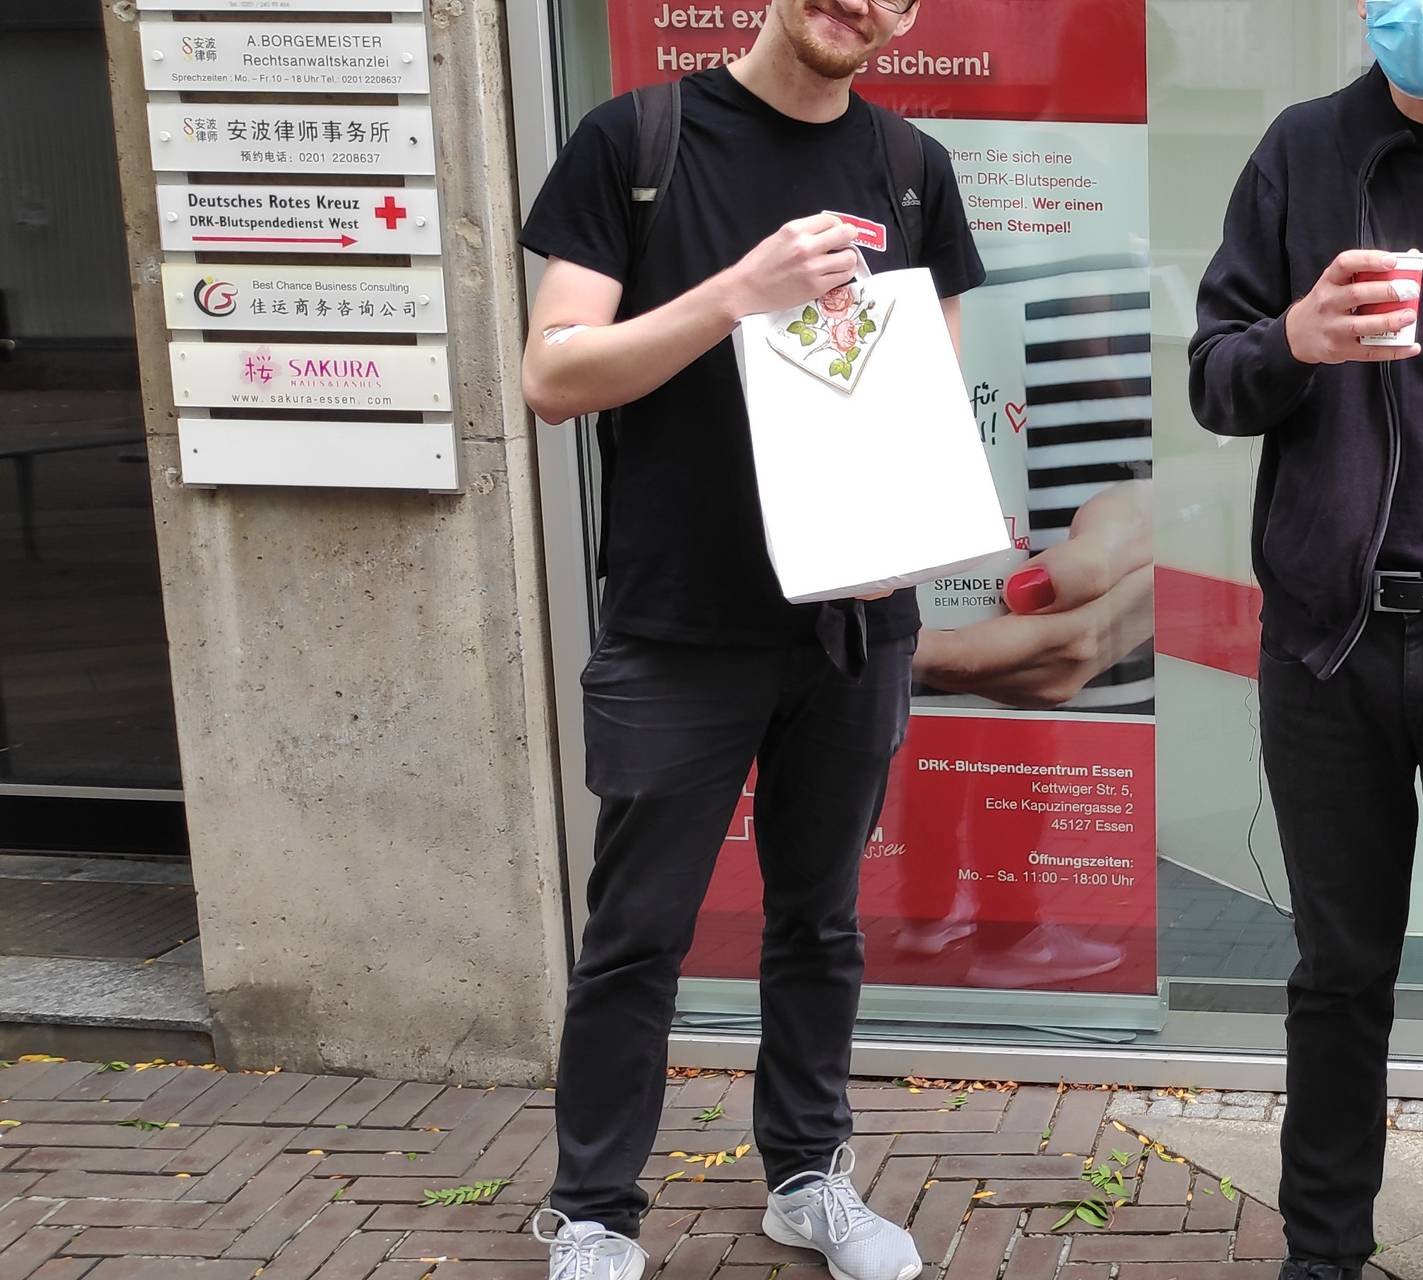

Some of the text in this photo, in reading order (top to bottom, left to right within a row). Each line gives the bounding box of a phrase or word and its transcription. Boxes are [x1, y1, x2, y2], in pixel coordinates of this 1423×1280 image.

[654, 4, 770, 29] Jetzt ex
[247, 35, 382, 49] A.BORGEMEISTER
[243, 54, 390, 68] Rechtsanwaltskanzlei
[657, 47, 746, 71] Herzb
[876, 50, 990, 76] sichern!
[342, 76, 362, 84] 0201
[365, 76, 402, 84] 2208637
[228, 120, 390, 144] 安波律师事务所
[299, 152, 325, 163] 0201
[332, 153, 380, 164] 2208637
[986, 150, 1008, 162] Sie
[1012, 150, 1040, 163] sich
[1044, 152, 1072, 164] eine
[958, 172, 1096, 189] im DRK-Blutspende-
[188, 193, 360, 210] Deutsches Rotes Kreuz
[968, 195, 1103, 211] Stempel. Wer einen
[190, 216, 359, 230] DRK-Blutspendedienst West
[968, 219, 1071, 234] chen Stempel!
[252, 280, 409, 294] Best Chance Business Consulting
[250, 298, 417, 318] 佳运商务咨询公司
[289, 359, 380, 378] SAKURA
[232, 394, 264, 403] www.
[367, 396, 392, 405] com
[970, 382, 999, 418] für
[934, 578, 992, 591] SPENDE
[934, 596, 960, 607] BEIM
[963, 595, 996, 606] ROTEN
[918, 759, 1133, 778] DRK-Blutspendezentrum Essen
[1032, 782, 1133, 797] Kettwiger Str. 5,
[986, 798, 1133, 815] Ecke Kapuzinergasse 2
[1052, 819, 1133, 832] 45127 Essen
[864, 844, 906, 859] ssen
[1028, 851, 1134, 869] Öffnungszeiten:
[958, 869, 982, 880] Mo.
[998, 870, 1018, 882] Sa.
[1023, 872, 1057, 883] 11:00
[1073, 873, 1107, 885] 18:00
[1112, 874, 1134, 886] Uhr
